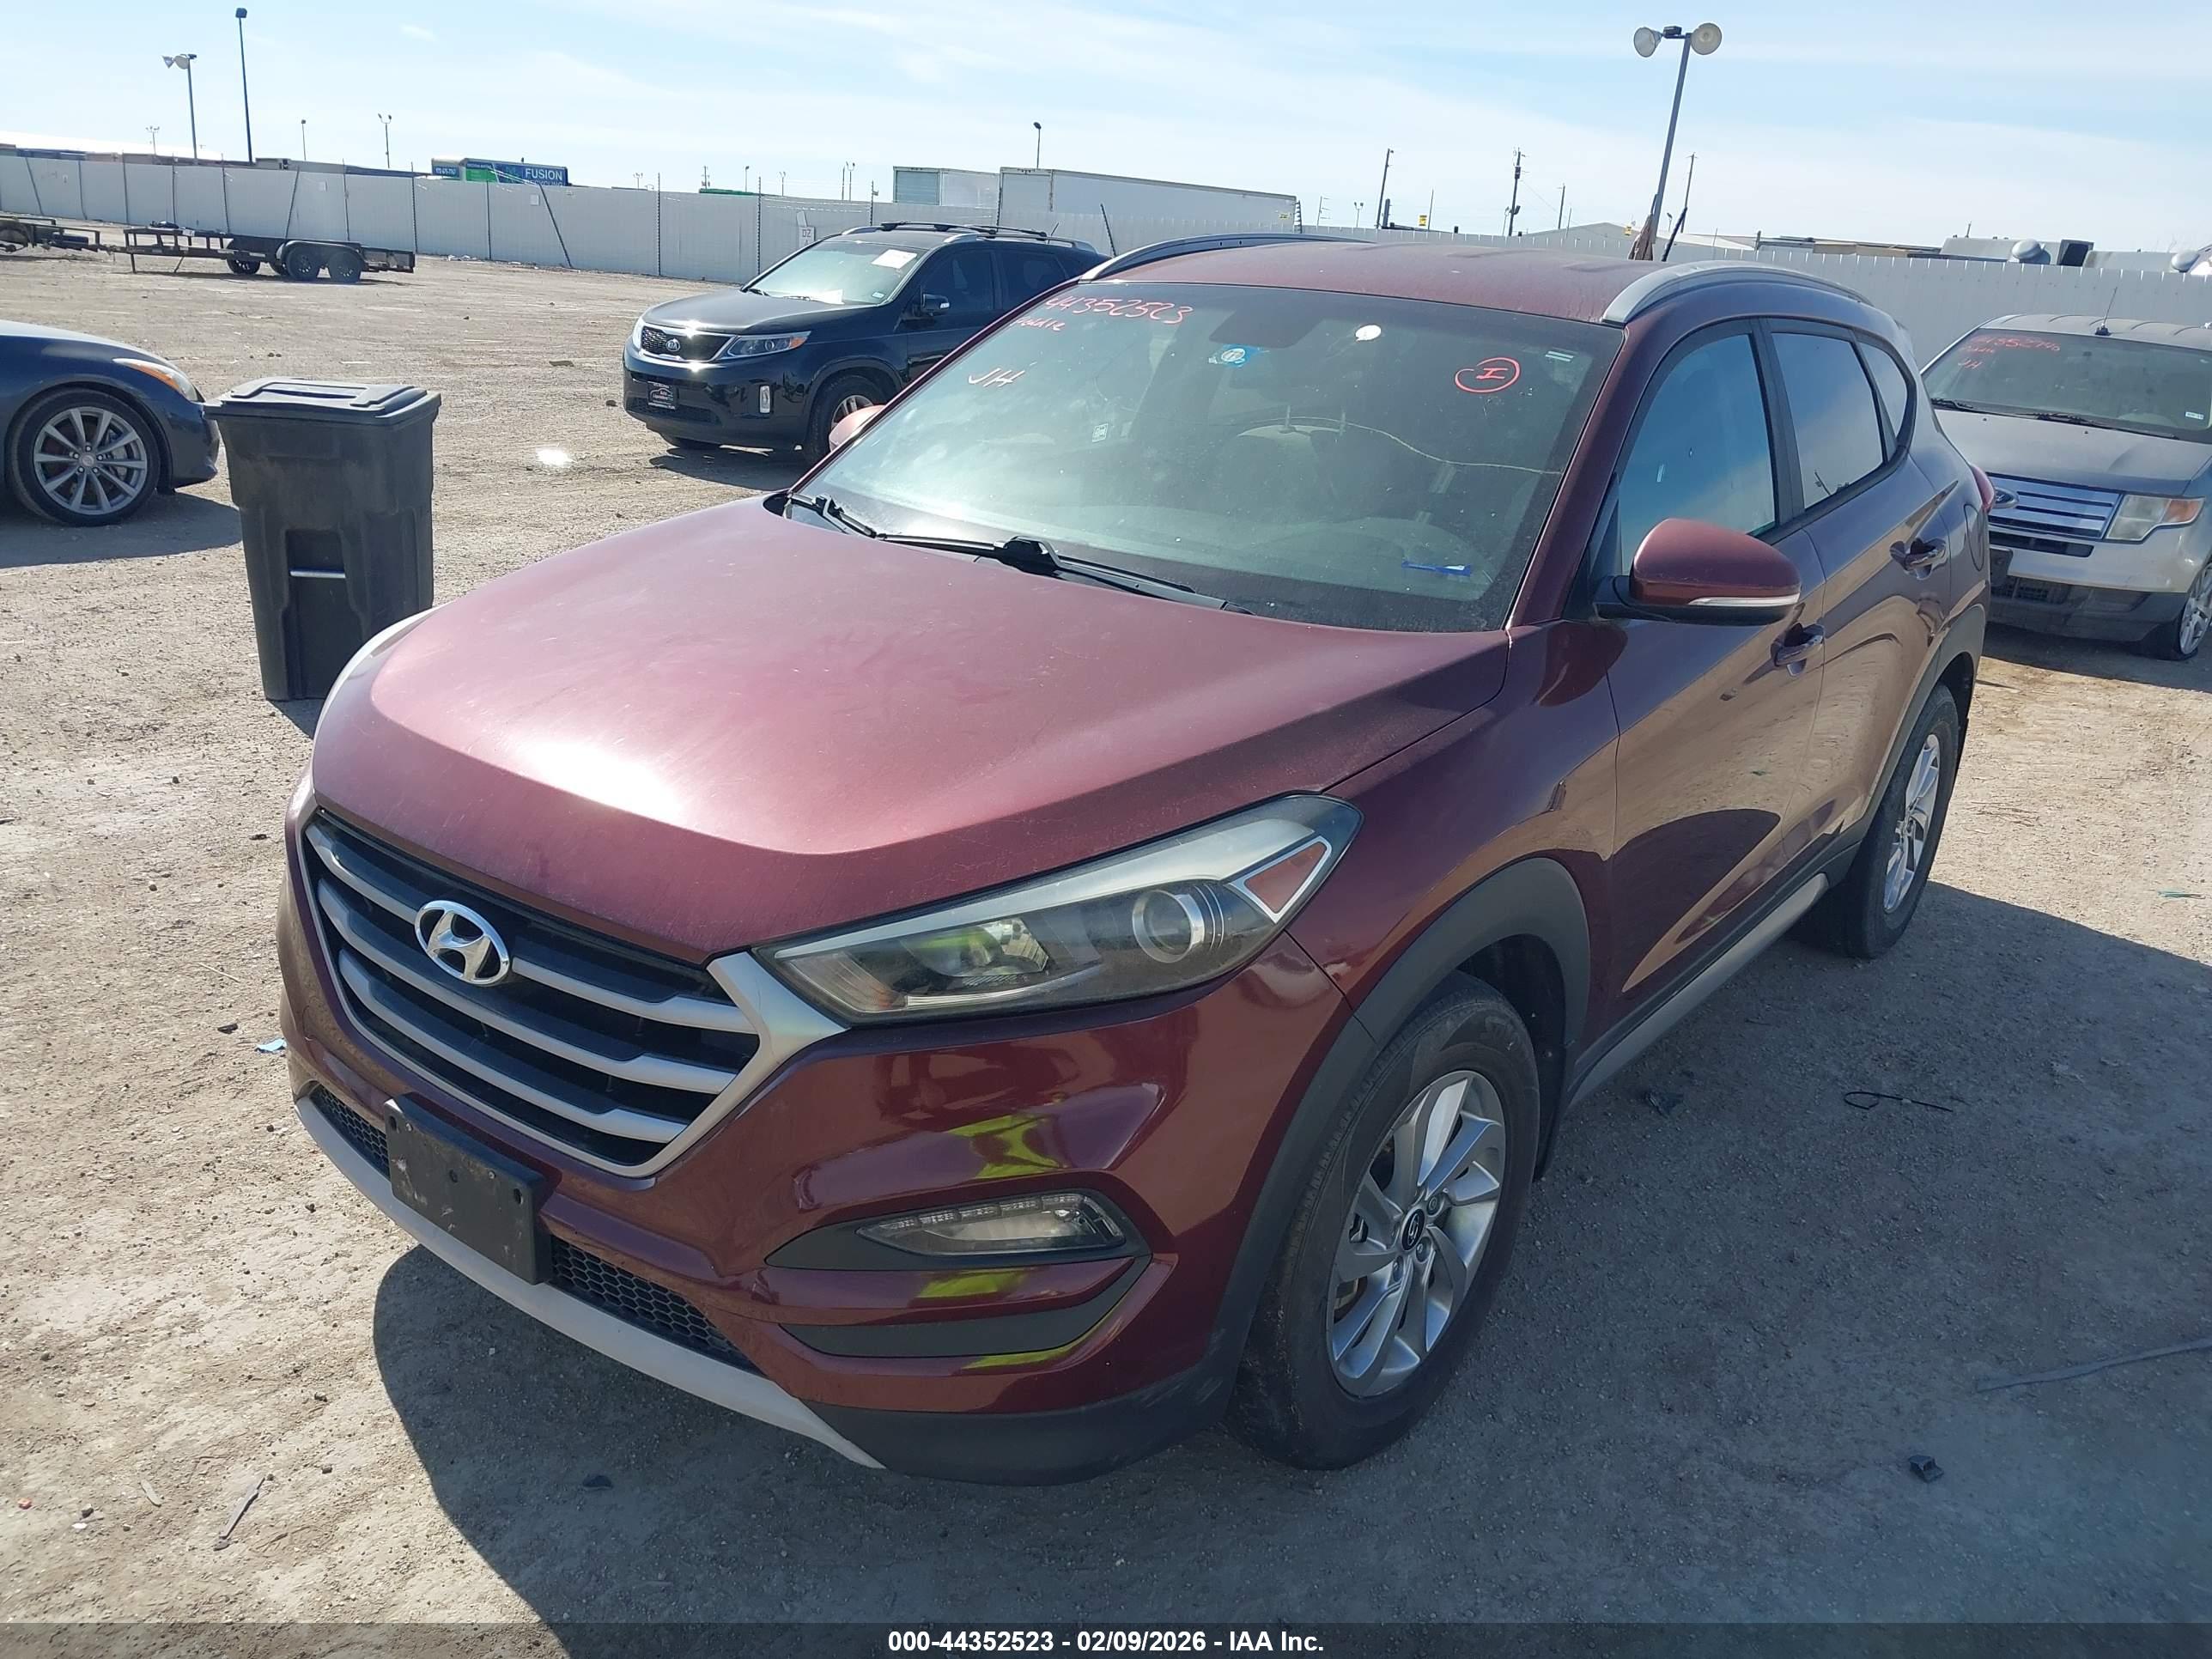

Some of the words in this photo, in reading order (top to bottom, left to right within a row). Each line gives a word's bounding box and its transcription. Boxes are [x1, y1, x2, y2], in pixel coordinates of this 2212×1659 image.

[525, 167, 563, 181] FUSION
[1043, 295, 1194, 325] 44352523
[968, 367, 1027, 388] JH
